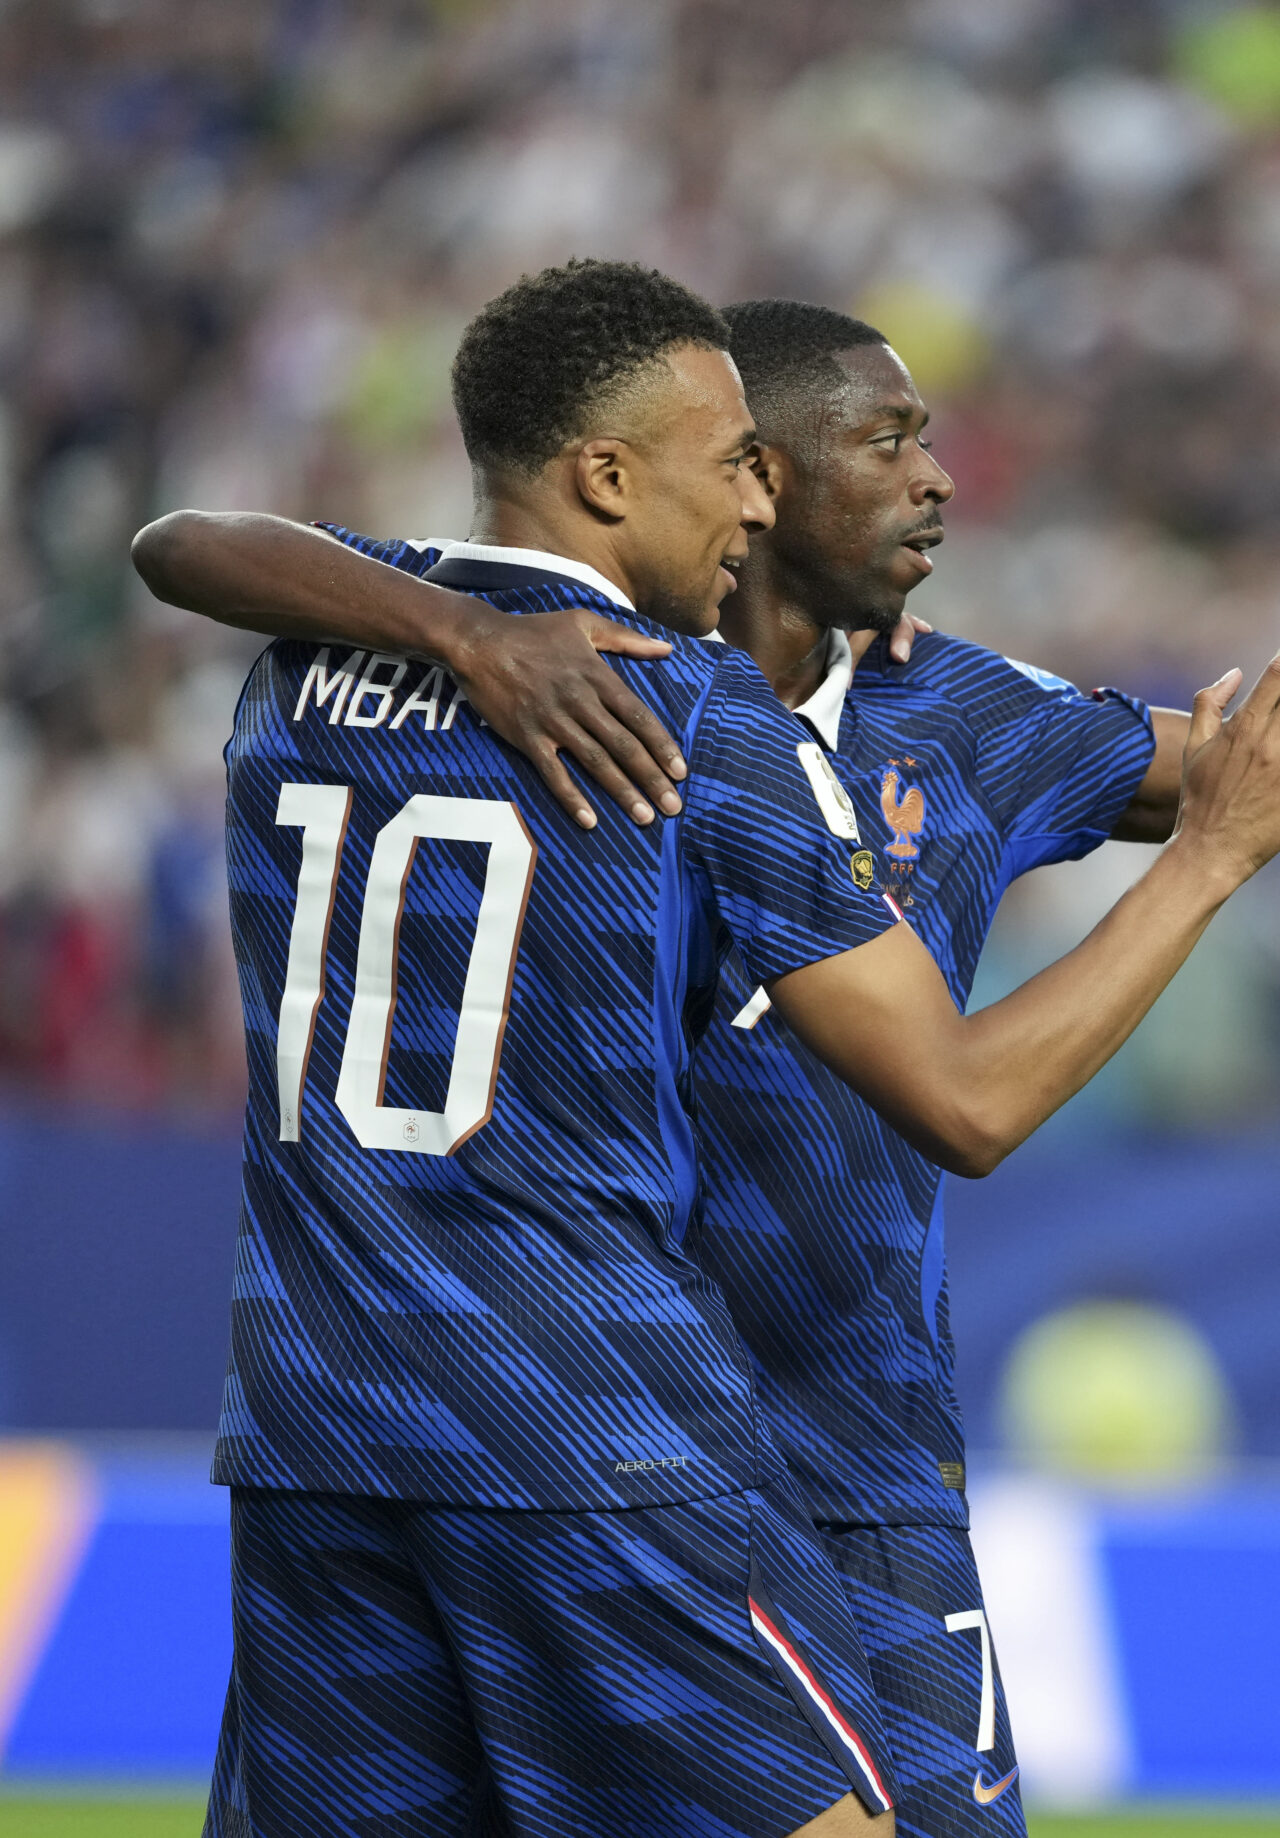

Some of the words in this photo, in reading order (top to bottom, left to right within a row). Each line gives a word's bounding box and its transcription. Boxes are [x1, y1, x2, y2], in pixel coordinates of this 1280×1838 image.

[275, 782, 539, 1157] 10
[615, 1456, 688, 1473] AERO-FIT
[944, 1609, 996, 1753] 7
